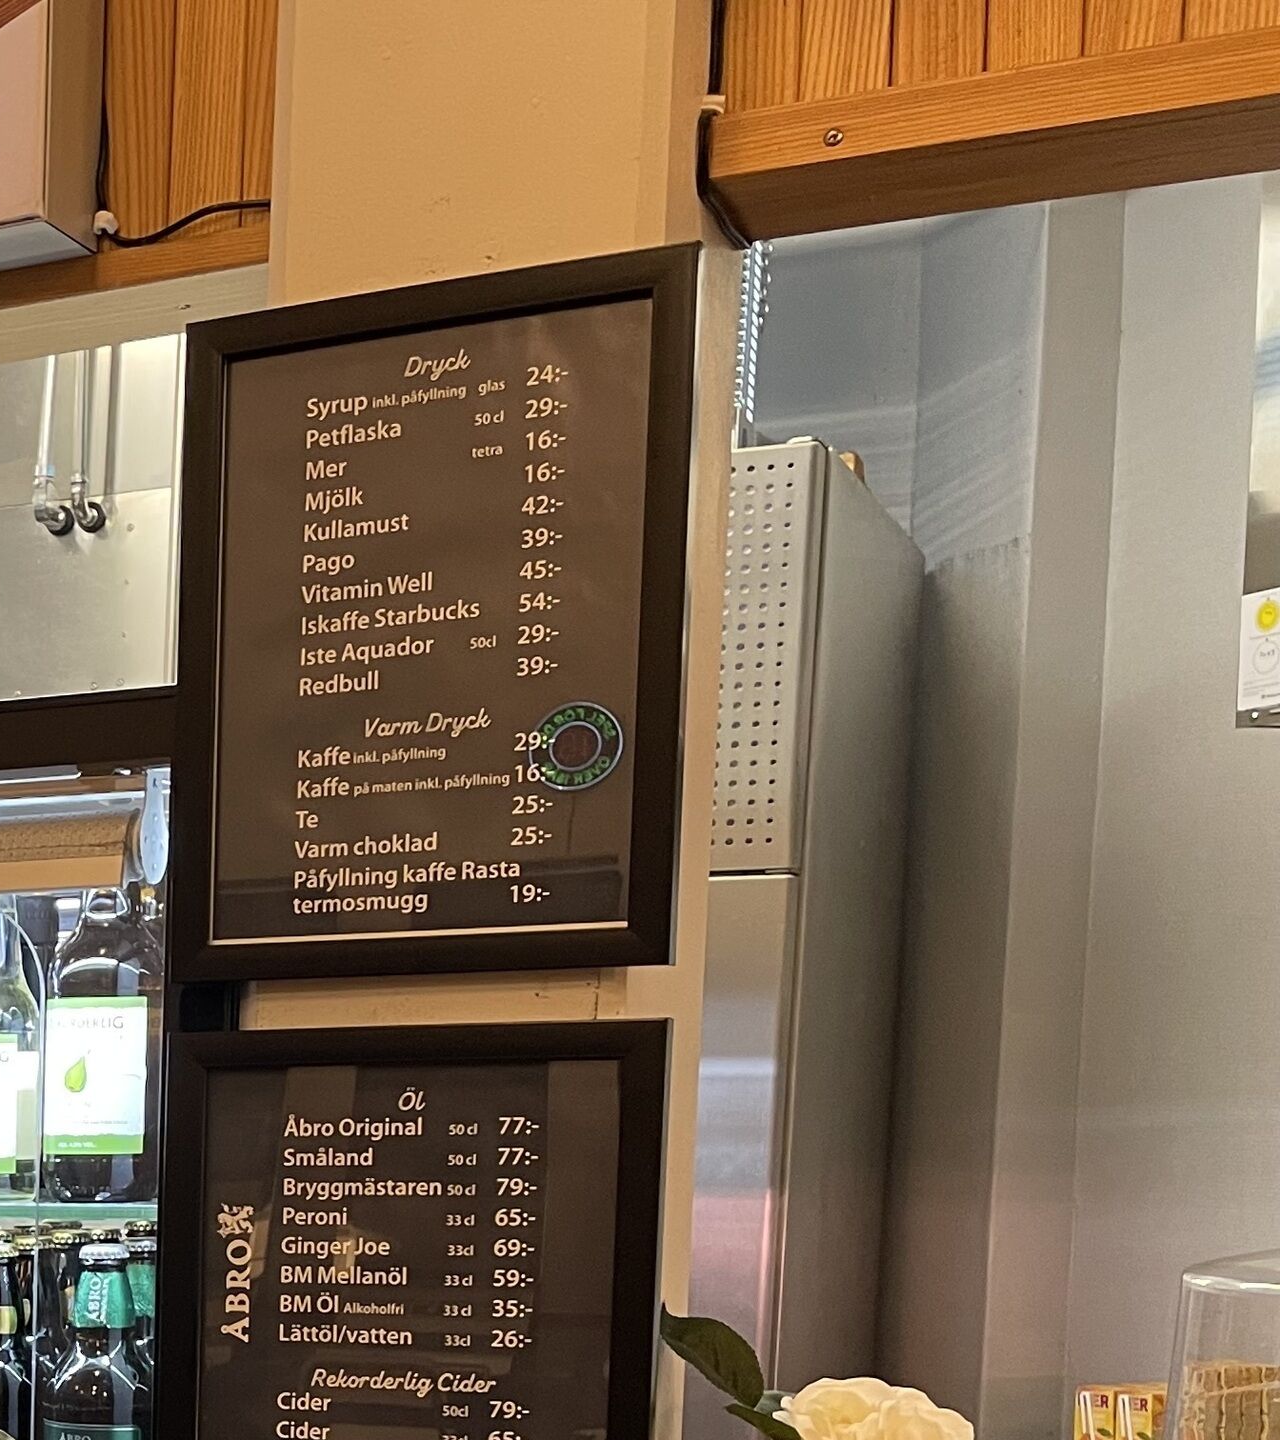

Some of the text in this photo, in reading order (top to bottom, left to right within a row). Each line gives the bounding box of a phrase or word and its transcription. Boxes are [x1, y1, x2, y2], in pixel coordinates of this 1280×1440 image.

[404, 349, 471, 380] Dryck
[307, 364, 569, 419] Syrup påfyllning glas 24:-
[306, 397, 568, 449] Petflaska 29:-
[306, 430, 566, 480] Mer tetra 16:-
[305, 463, 565, 512] Mjölk 16:-
[303, 494, 563, 542] Kullamust 42:-
[302, 527, 563, 575] Pago 39:-
[302, 560, 561, 604] Vitamin Well 45:-
[301, 592, 560, 635] Iskaffe Starbucks 54:-
[300, 624, 559, 665] Iste Aquador 29:-
[299, 656, 558, 696] Redbull 39:-
[364, 709, 491, 738] Varm Dryck
[297, 745, 446, 767] Kaffe påfyllning
[297, 772, 510, 799] Kaffe maten påfyllning
[296, 795, 553, 829] Te 25:-
[295, 826, 552, 860] Varm choklad 25:-
[294, 860, 520, 892] Påfyllning kaffe Rasta
[293, 884, 550, 916] termosmugg 19:-
[398, 1087, 425, 1111] Öl
[284, 1114, 539, 1140] Åbro Original 77:-
[284, 1148, 539, 1167] Småland 77:-
[283, 1178, 537, 1199] Bryggmästaren 79:-
[282, 1207, 536, 1227] Peroni 65:-
[281, 1238, 535, 1259] Ginger Joe 69:-
[221, 1238, 252, 1343] ÅBRO
[280, 1267, 534, 1288] BM Mellanöl 59:-
[279, 1293, 533, 1318] BM Öl Alkoholfri 35:-
[279, 1324, 532, 1348] Lättöl/vatten 26:-
[311, 1369, 496, 1397] Rekorderlig Cider
[276, 1392, 530, 1420] Cider 79:-
[276, 1421, 330, 1440] Cider
